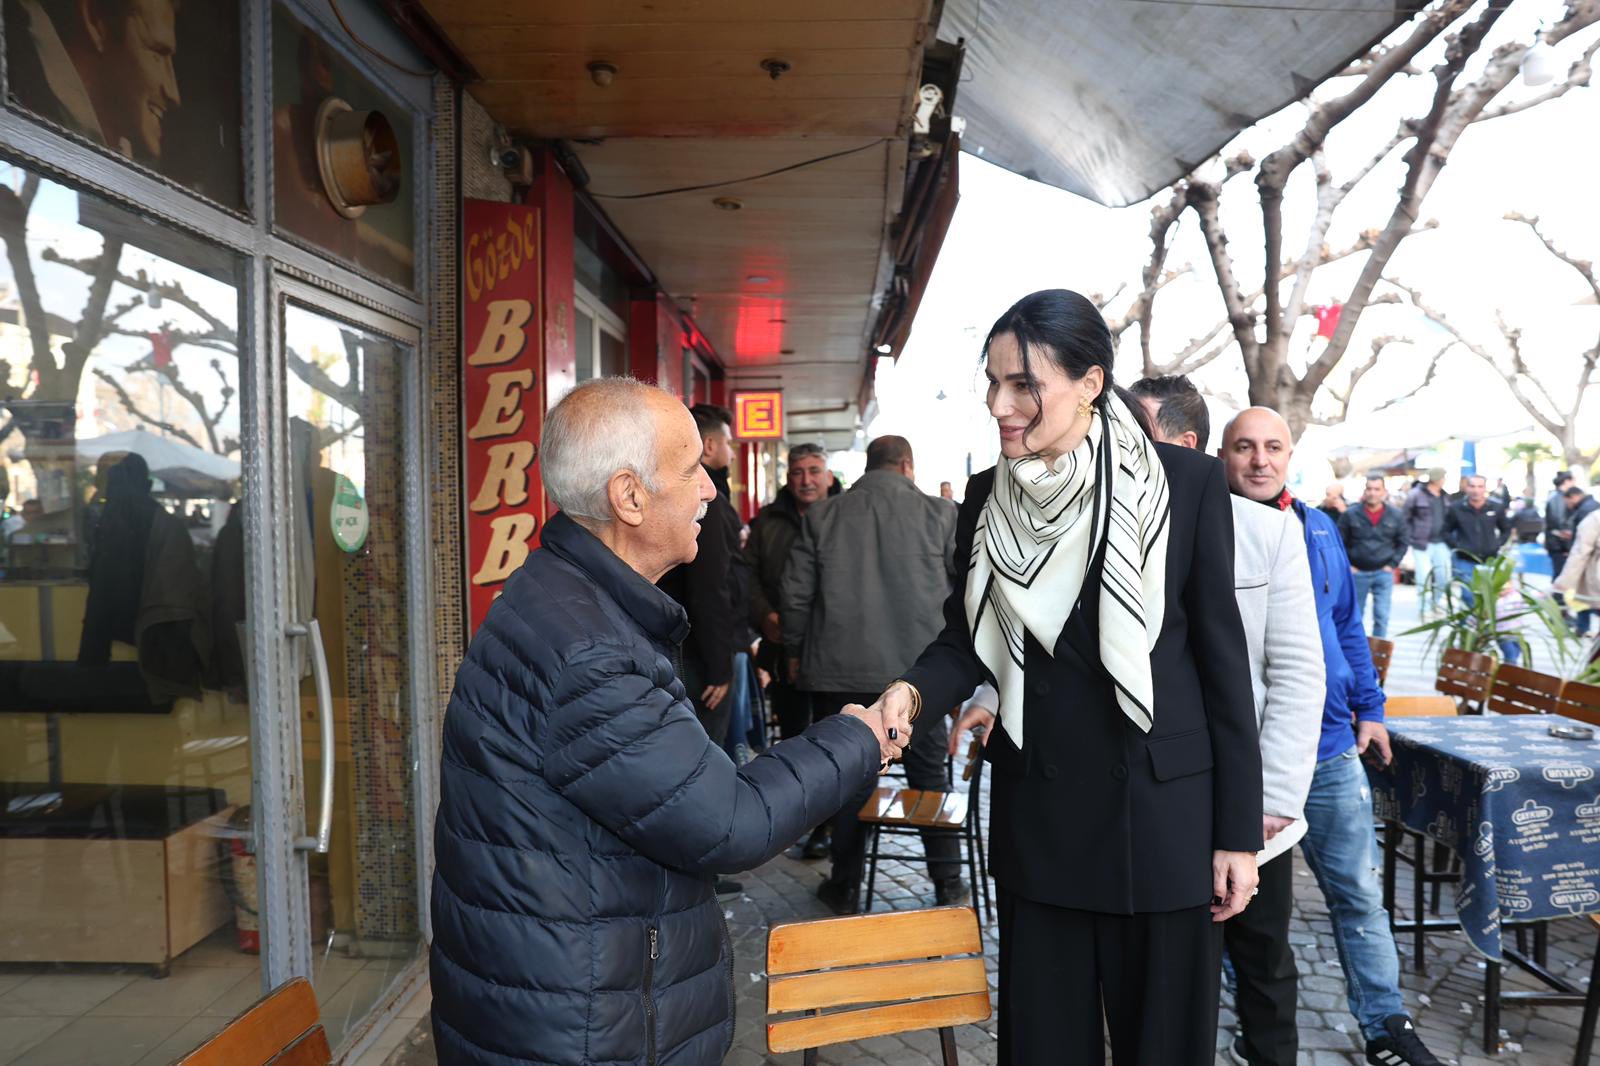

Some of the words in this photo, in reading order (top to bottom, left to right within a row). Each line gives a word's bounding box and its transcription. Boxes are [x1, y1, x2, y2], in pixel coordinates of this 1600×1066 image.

[465, 212, 536, 302] Gözde
[467, 299, 537, 599] BERB
[747, 401, 770, 430] E
